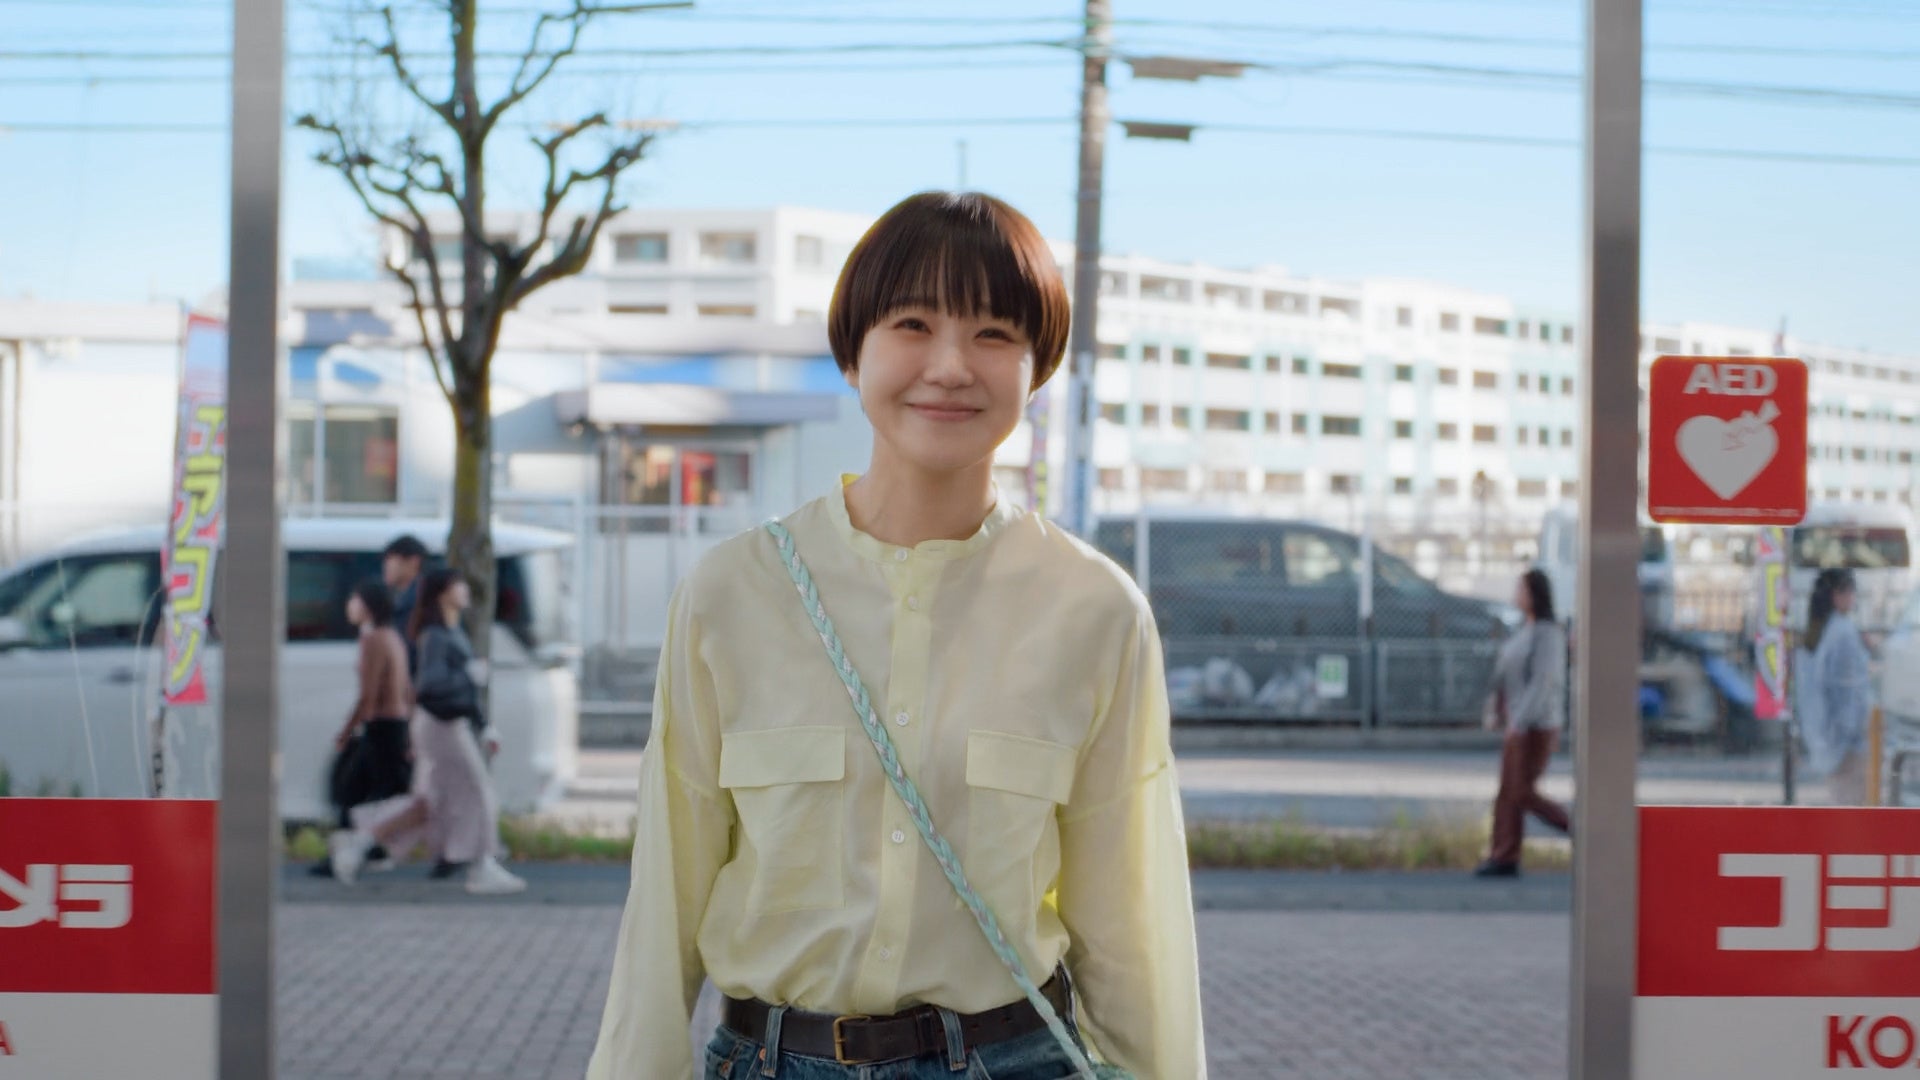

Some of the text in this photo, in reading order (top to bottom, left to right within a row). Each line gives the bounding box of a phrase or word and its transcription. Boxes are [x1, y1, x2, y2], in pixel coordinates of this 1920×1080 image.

[1683, 363, 1777, 396] AED
[170, 402, 226, 686] エアコン
[1716, 853, 1920, 952] コジ
[1826, 1014, 1920, 1070] KO
